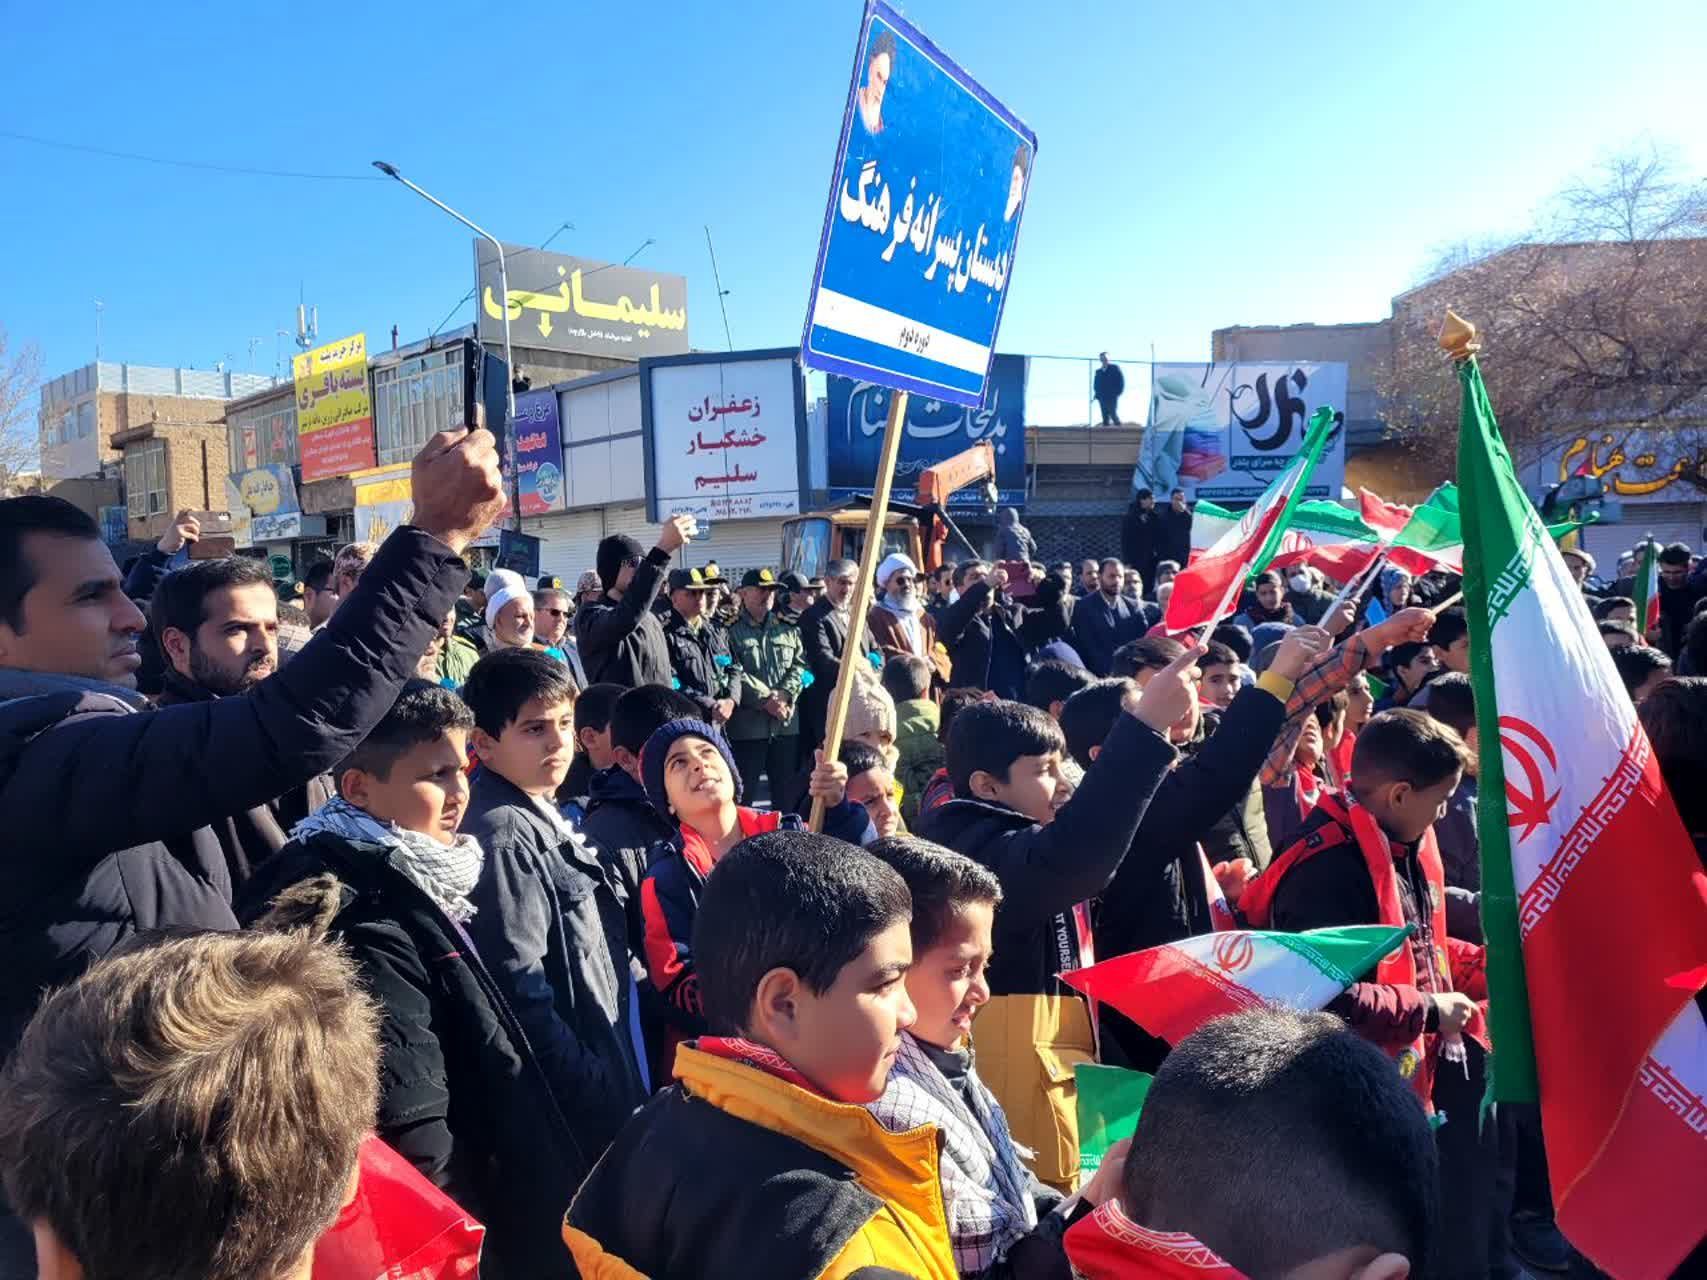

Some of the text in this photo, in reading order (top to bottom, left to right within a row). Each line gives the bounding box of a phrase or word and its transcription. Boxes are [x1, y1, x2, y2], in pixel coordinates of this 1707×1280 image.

[839, 160, 1009, 304] دبستان پسرانه فرهنگ
[484, 265, 686, 338] سلیمانی
[299, 370, 339, 411] باقری
[687, 394, 760, 422] زعفران
[686, 427, 767, 456] خشکبار
[695, 463, 758, 491] سلیم
[1055, 912, 1065, 924] IT
